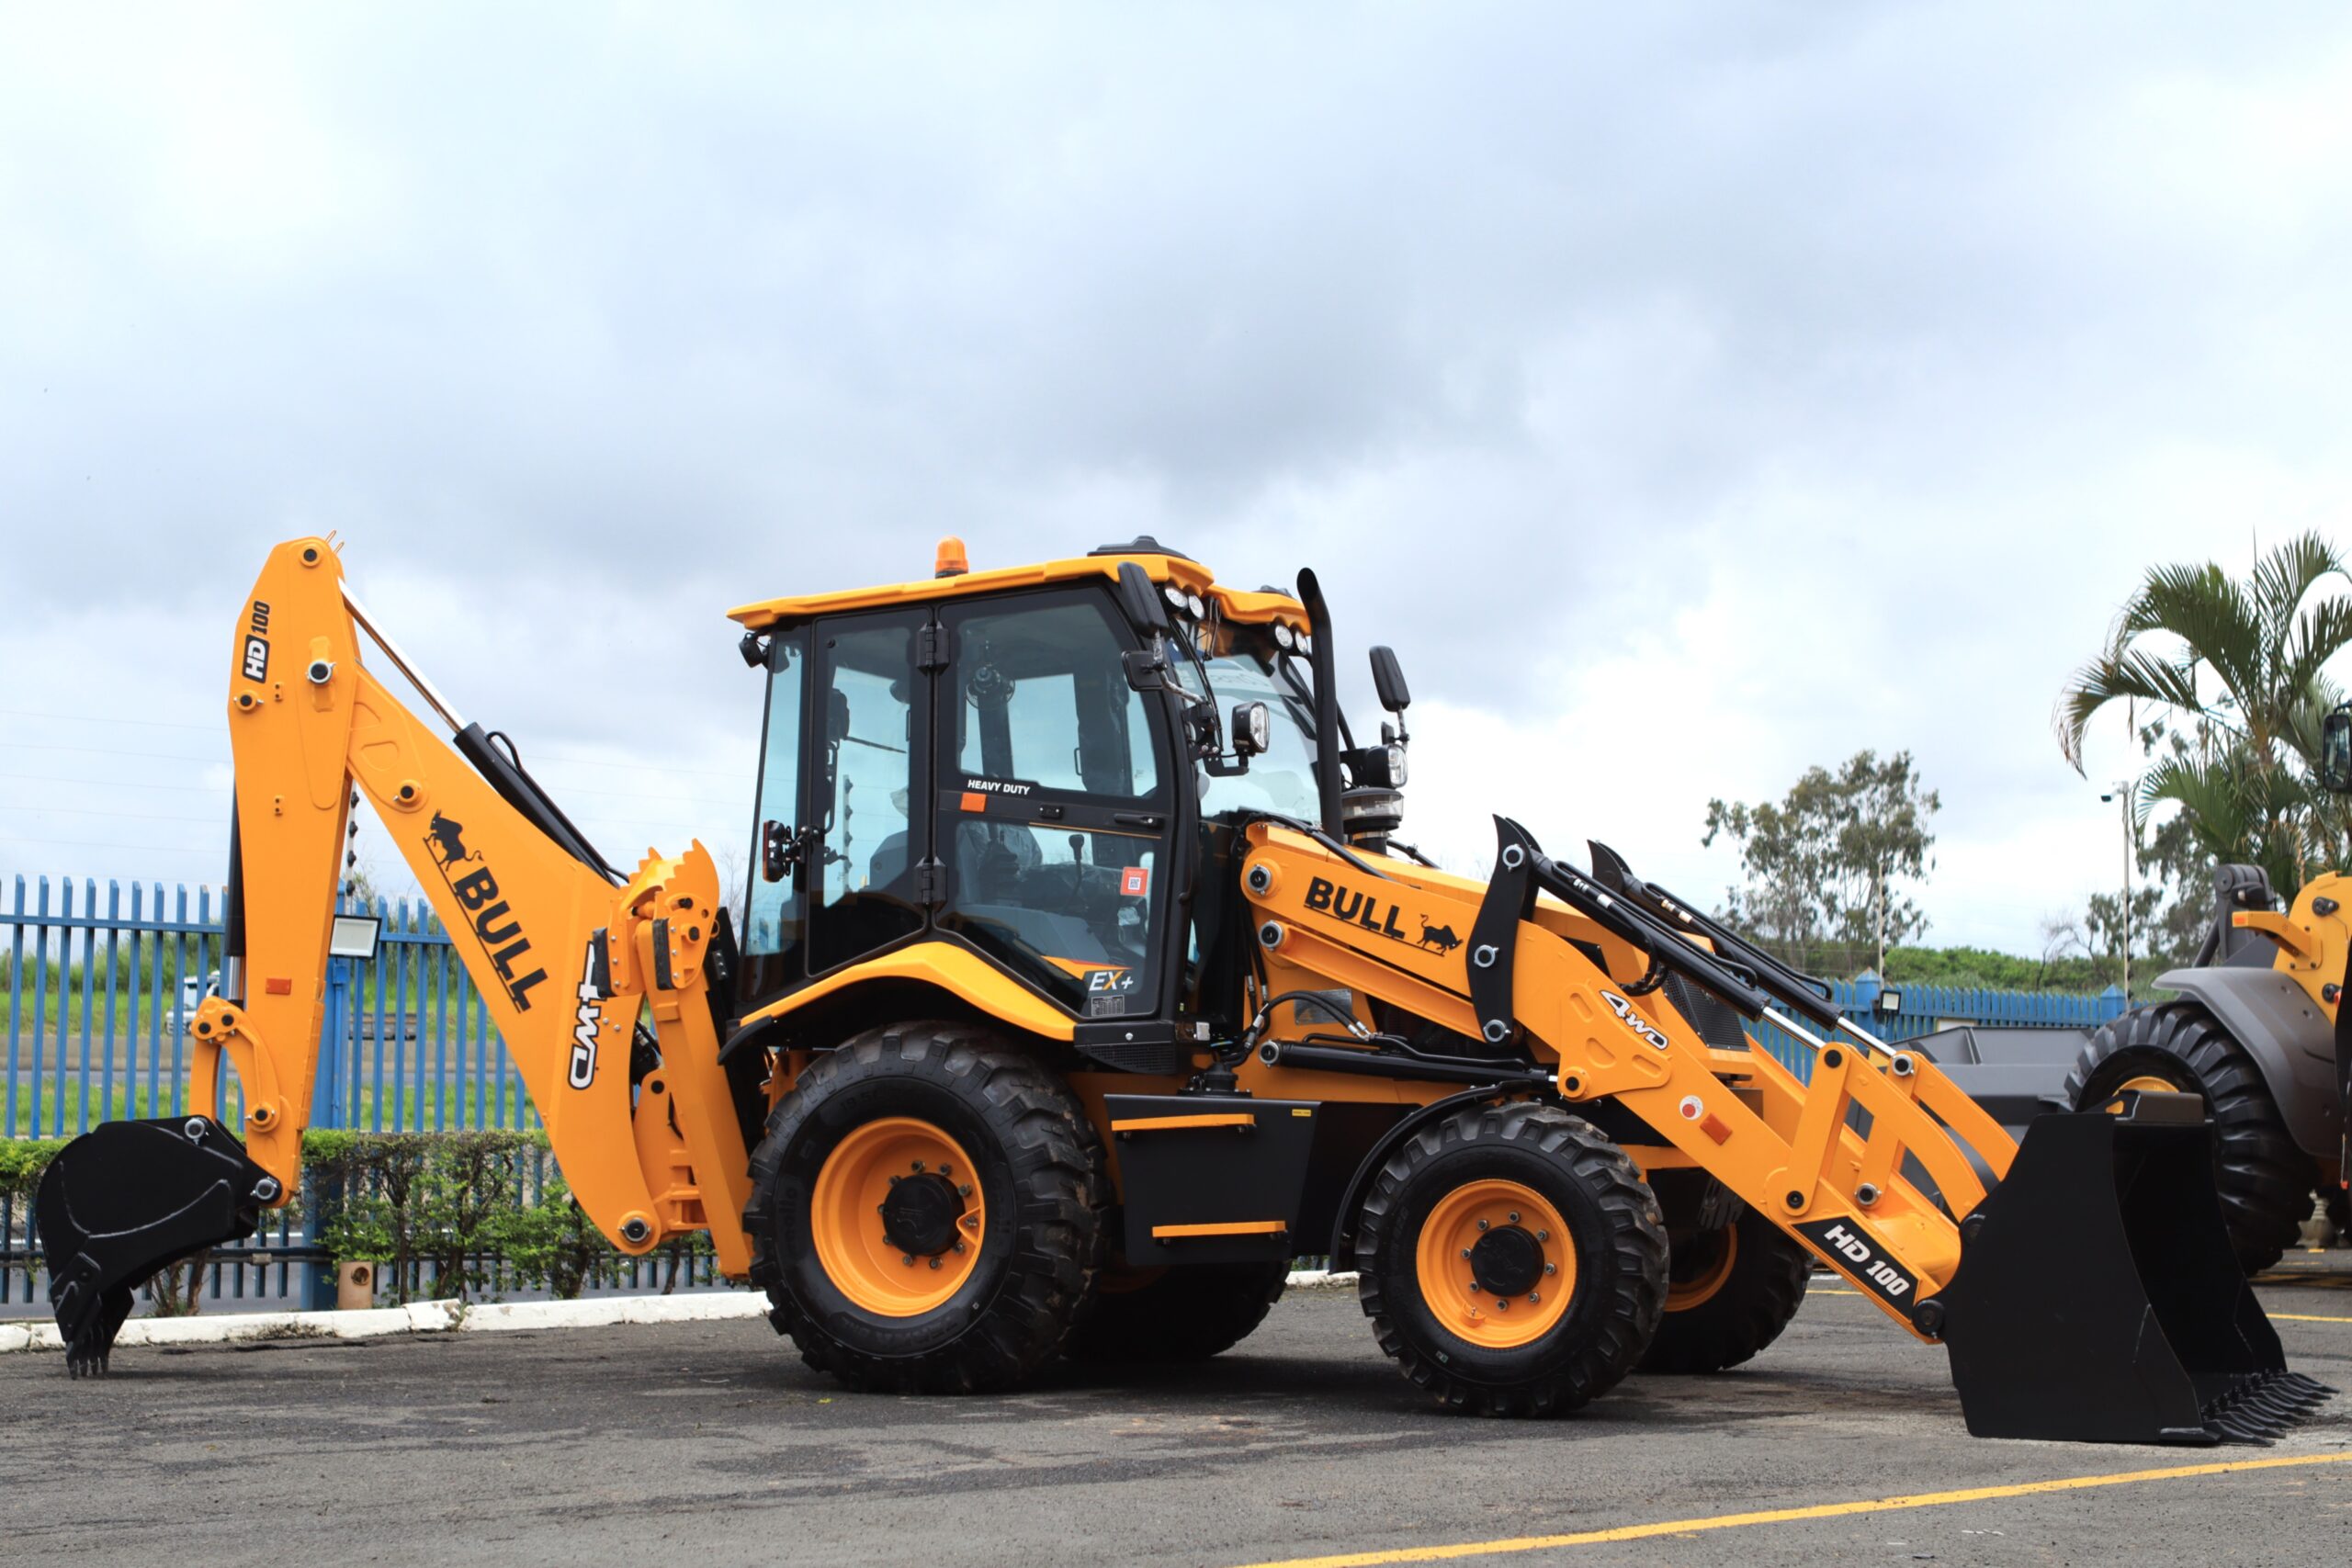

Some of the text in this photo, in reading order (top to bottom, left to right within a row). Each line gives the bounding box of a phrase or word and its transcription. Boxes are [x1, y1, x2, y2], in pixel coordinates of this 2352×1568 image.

[244, 600, 270, 680] HD 100
[967, 779, 1031, 795] HEAVY DUTY
[453, 865, 548, 1012] BULL
[1304, 875, 1406, 940] BULL
[1089, 970, 1134, 991] EX+
[1599, 989, 1669, 1051] 4WD
[1823, 1224, 1910, 1296] HD 100
